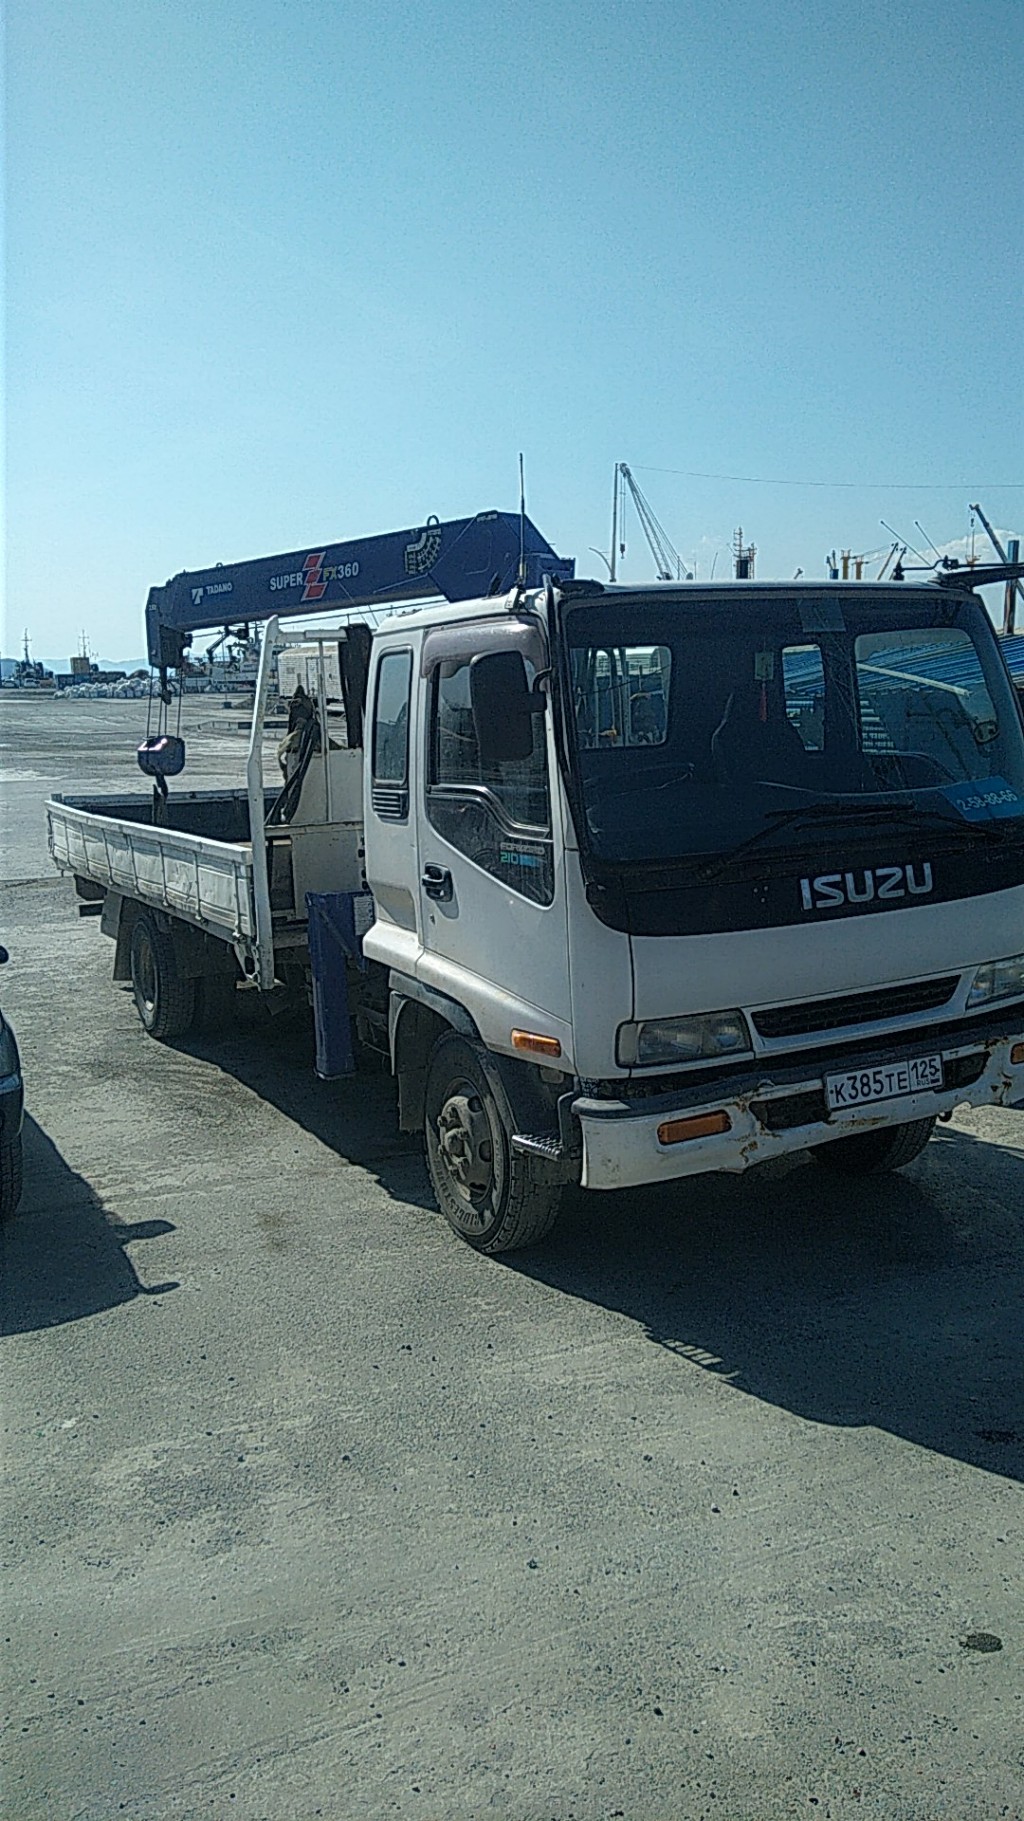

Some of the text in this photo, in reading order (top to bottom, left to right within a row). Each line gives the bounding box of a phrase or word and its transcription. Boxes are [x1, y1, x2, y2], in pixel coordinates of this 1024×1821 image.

[206, 582, 233, 596] TADANO
[269, 572, 303, 591] SUPER
[800, 862, 934, 911] ISUZU
[910, 1057, 940, 1080] 125
